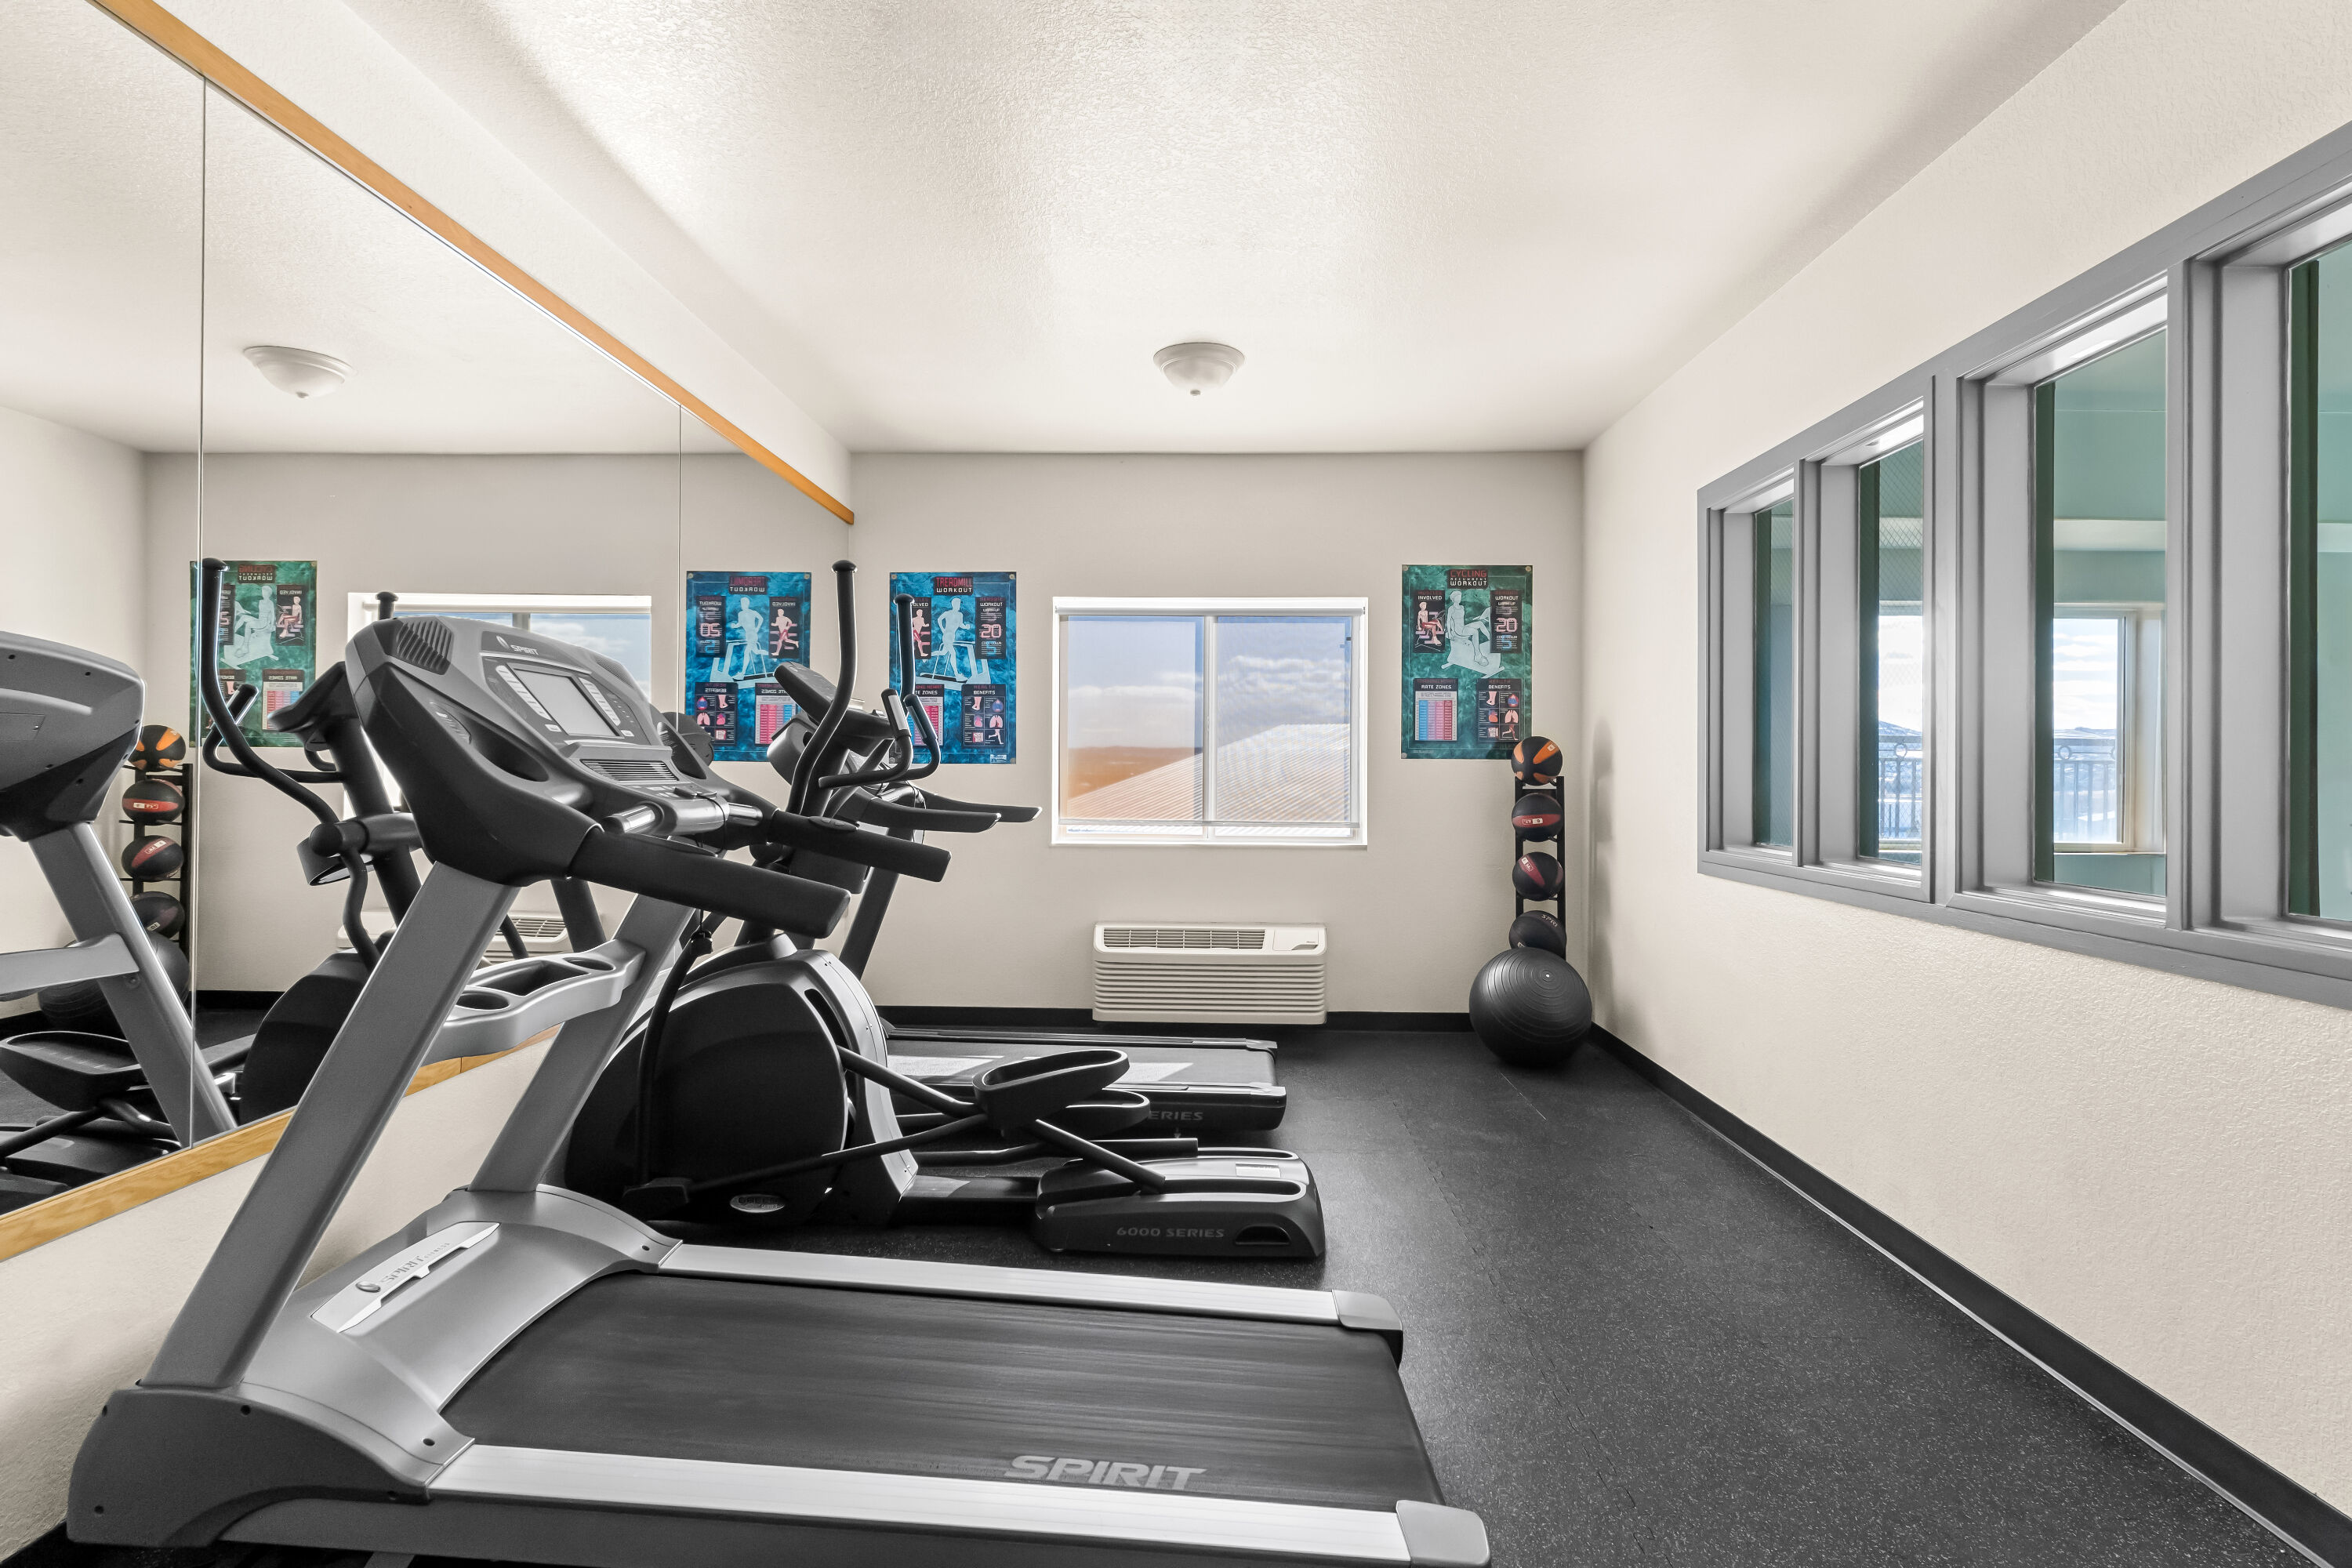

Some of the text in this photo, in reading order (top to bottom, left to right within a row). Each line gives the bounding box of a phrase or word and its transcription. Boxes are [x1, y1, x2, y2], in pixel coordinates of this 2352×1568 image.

[936, 577, 972, 586] TREADMILL
[981, 624, 1002, 638] 20
[1496, 618, 1517, 632] 20
[1501, 635, 1512, 650] 5
[510, 644, 539, 655] SPIRIT
[1541, 914, 1558, 927] SPRI
[1148, 1110, 1203, 1121] ERIES
[1116, 1226, 1225, 1239] 6000 SERIES
[381, 1255, 424, 1283] SPIRIT
[1004, 1455, 1207, 1490] SPIRIT
